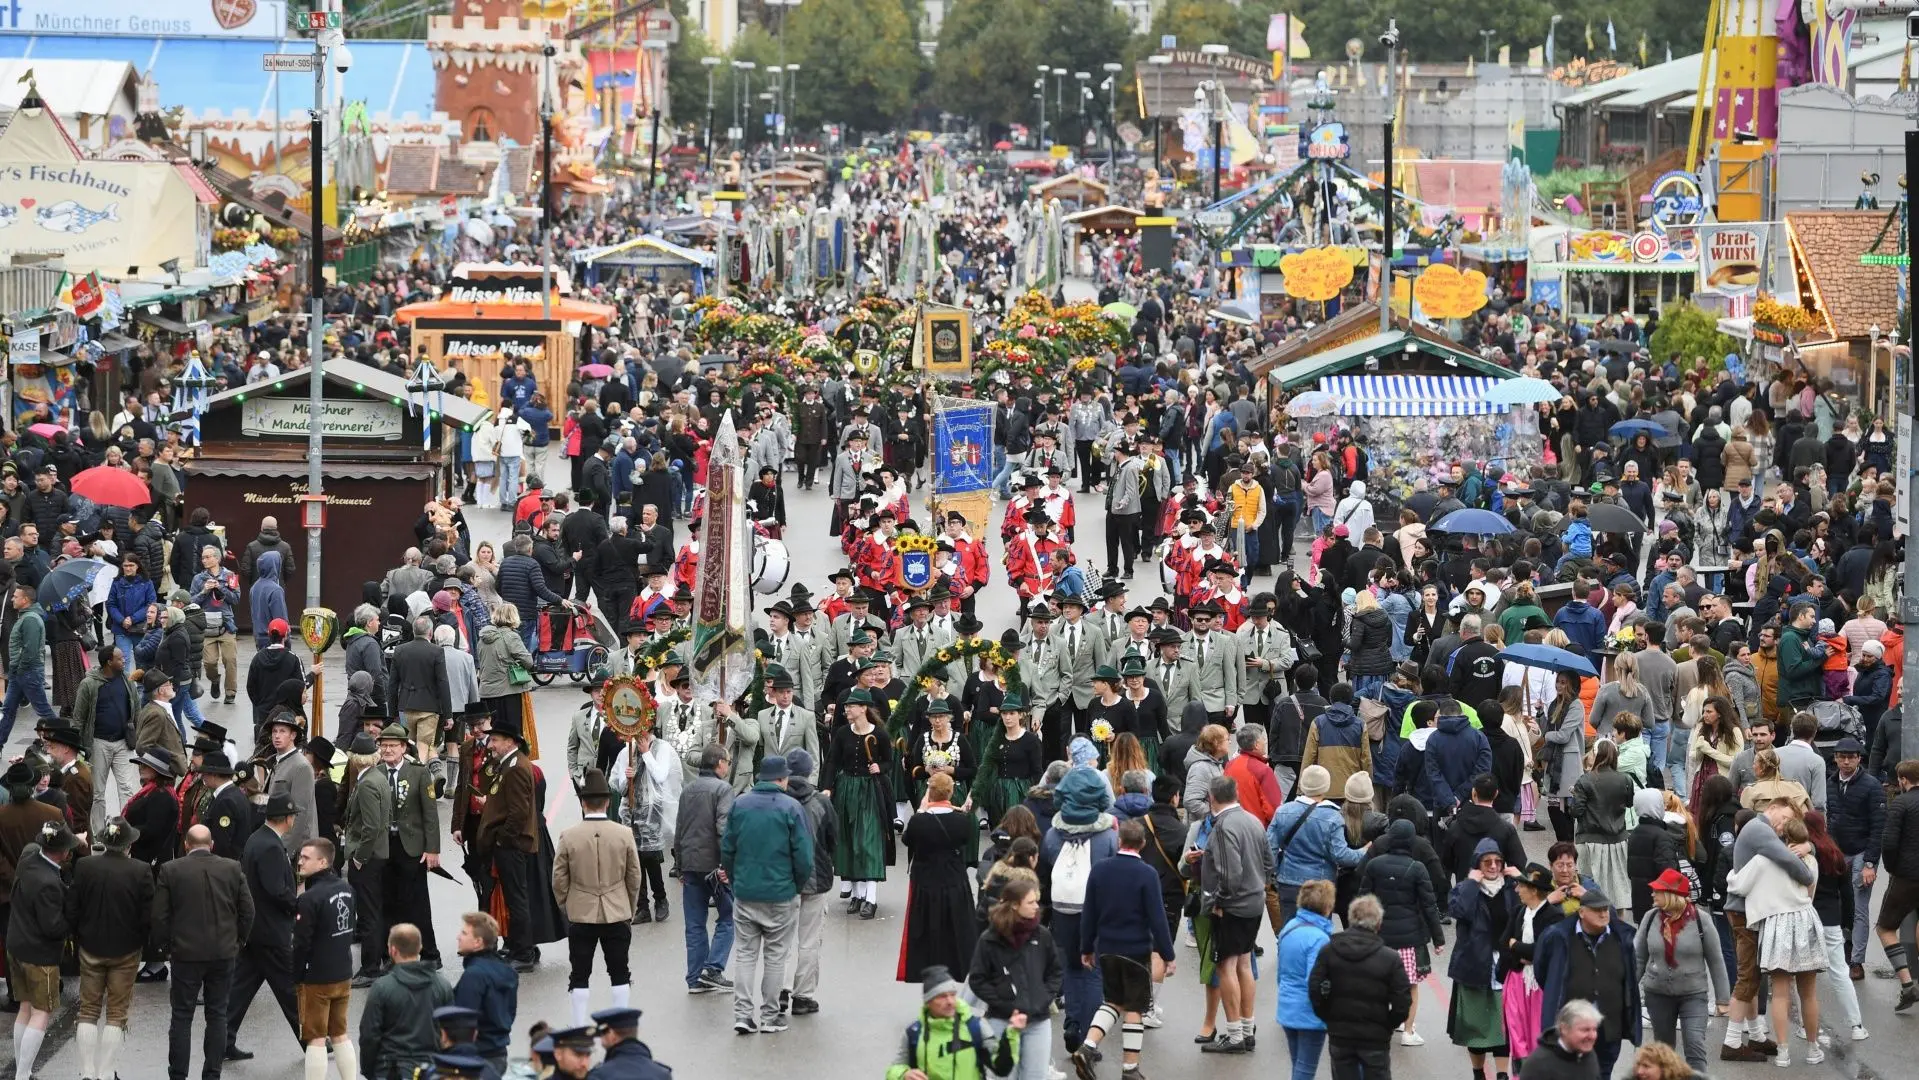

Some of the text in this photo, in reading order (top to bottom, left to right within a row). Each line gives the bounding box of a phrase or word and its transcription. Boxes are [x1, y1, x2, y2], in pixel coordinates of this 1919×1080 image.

[35, 13, 192, 33] Münchner Genuss
[29, 164, 132, 199] Fischhaus
[1715, 231, 1755, 246] Brat-
[1711, 245, 1756, 261] wurst
[450, 286, 502, 302] Heisse
[447, 340, 497, 356] Heisse
[292, 403, 354, 416] Müchner
[272, 419, 374, 433] Manderennerei
[243, 492, 292, 504] Münchner
